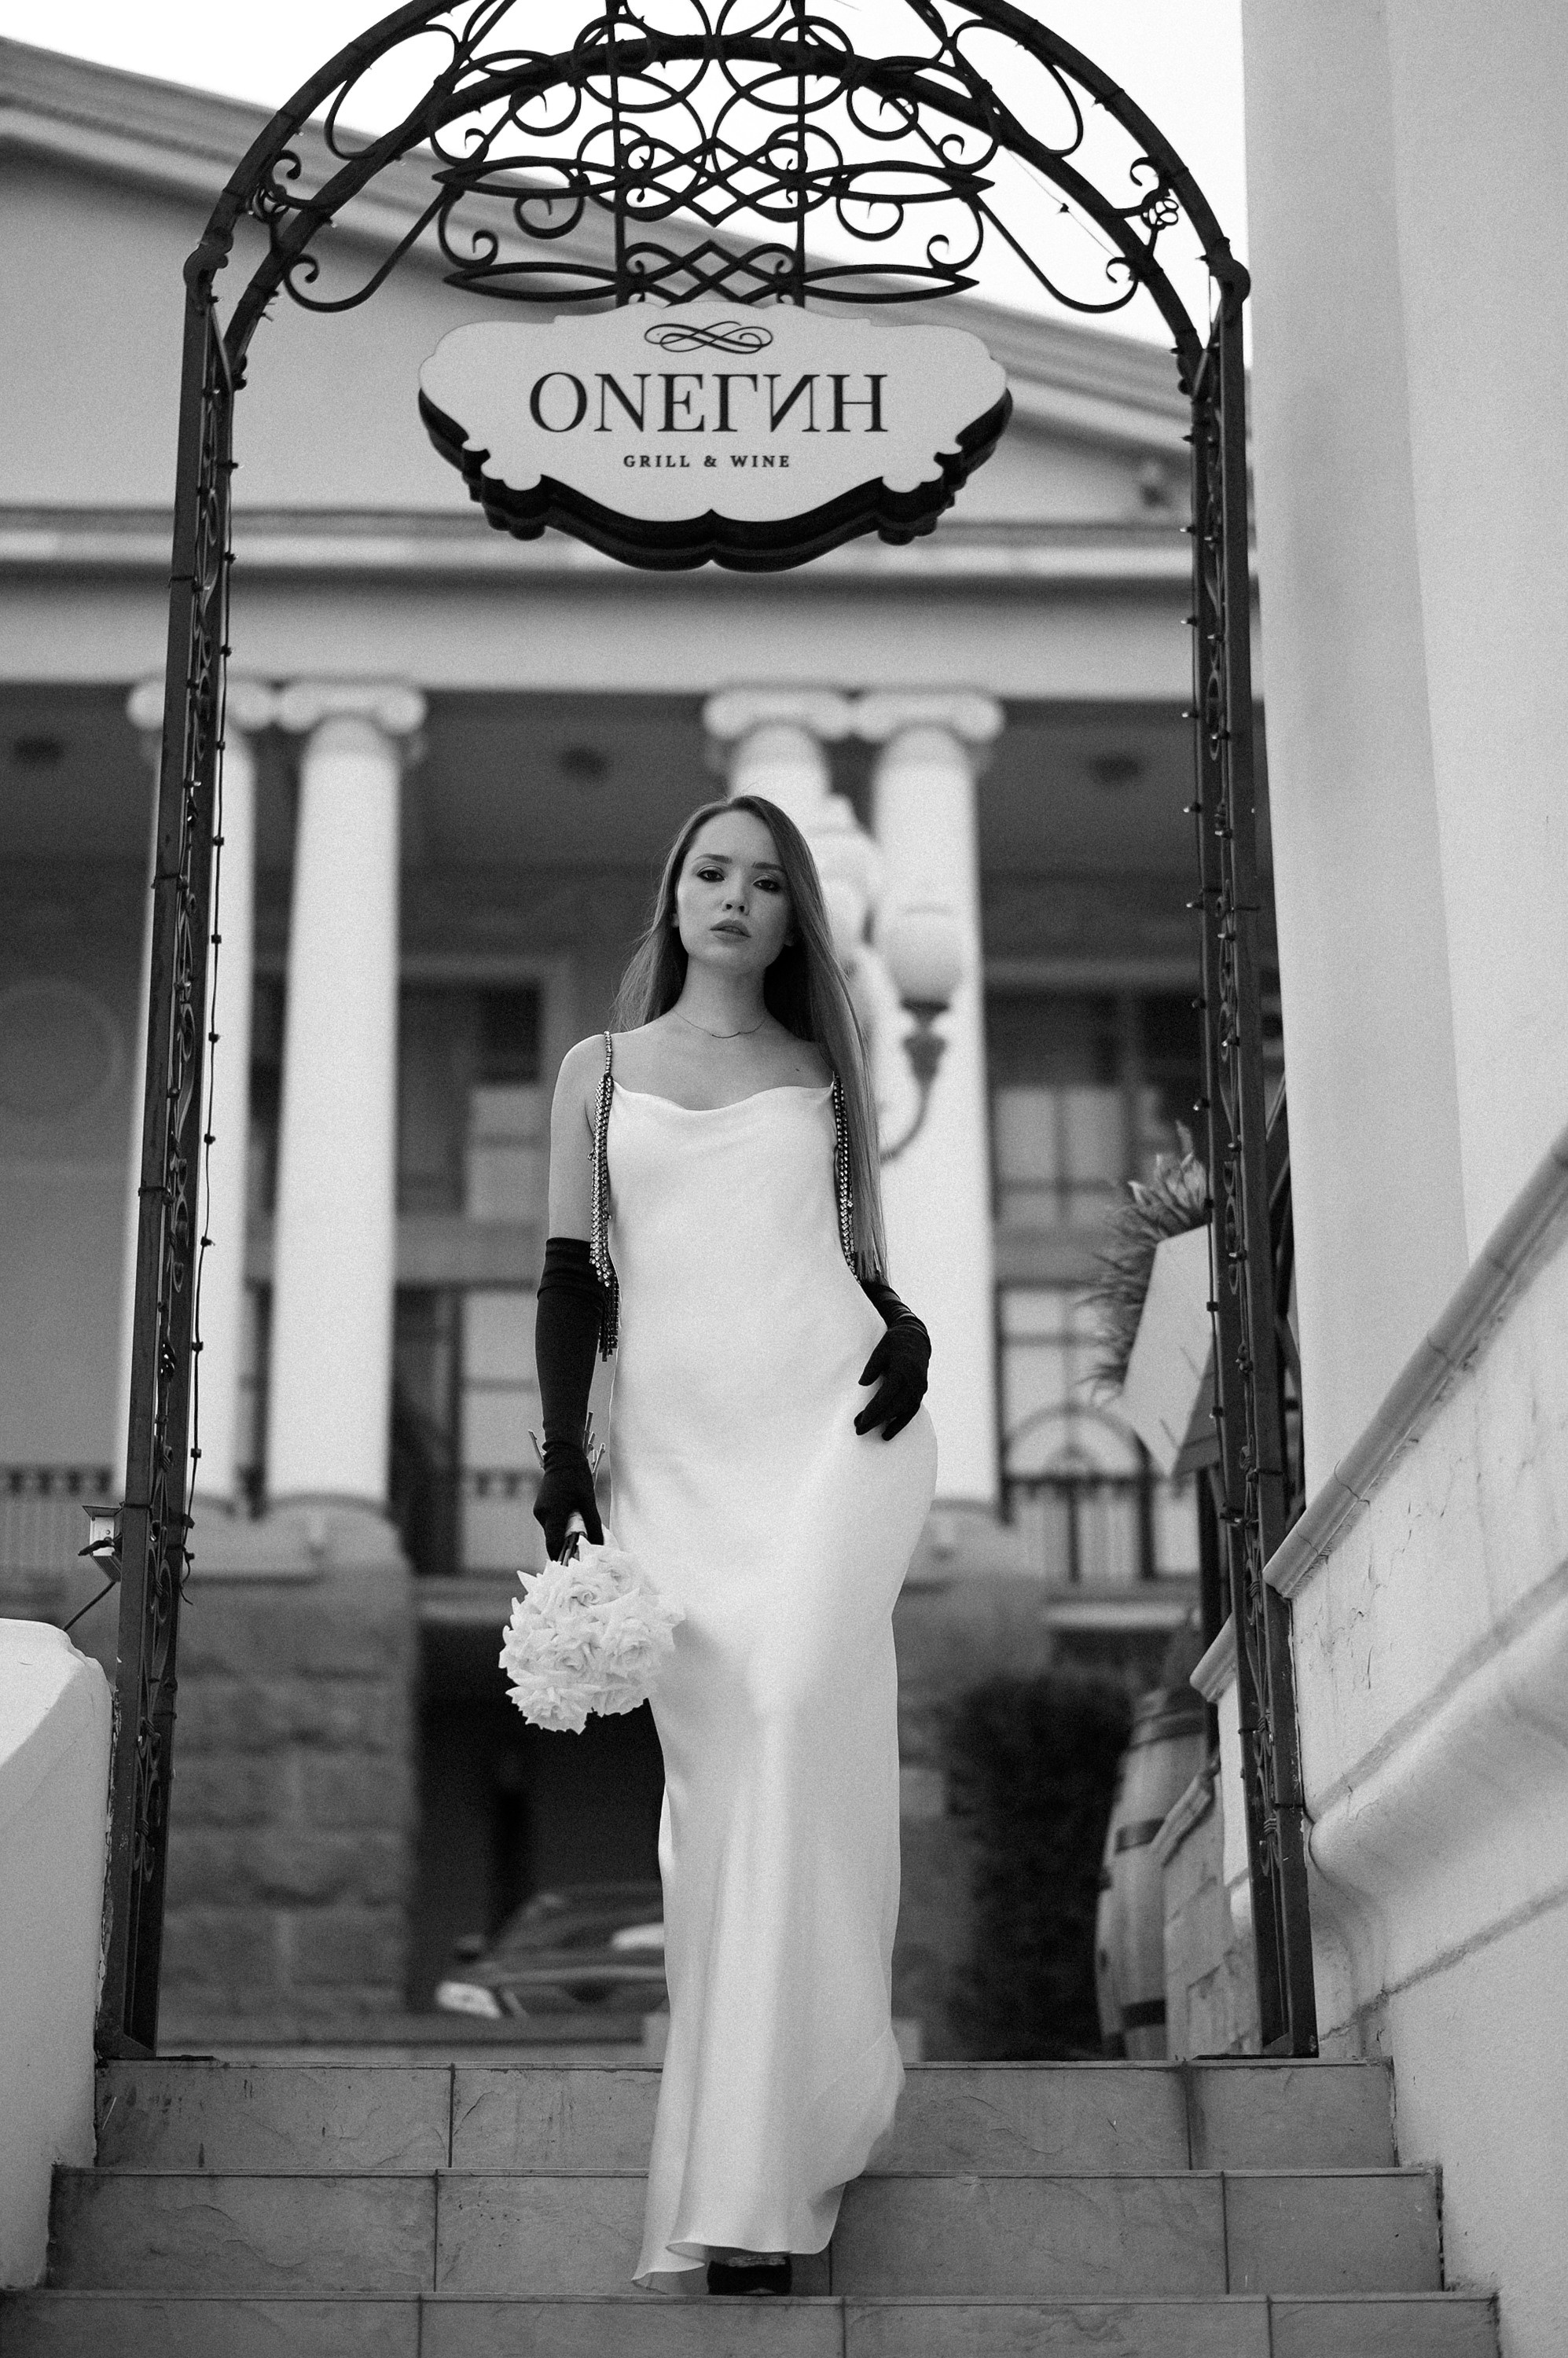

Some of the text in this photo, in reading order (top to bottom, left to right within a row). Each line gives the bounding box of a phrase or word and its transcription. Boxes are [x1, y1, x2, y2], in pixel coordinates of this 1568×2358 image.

[623, 454, 790, 468] GRILL & WINE
